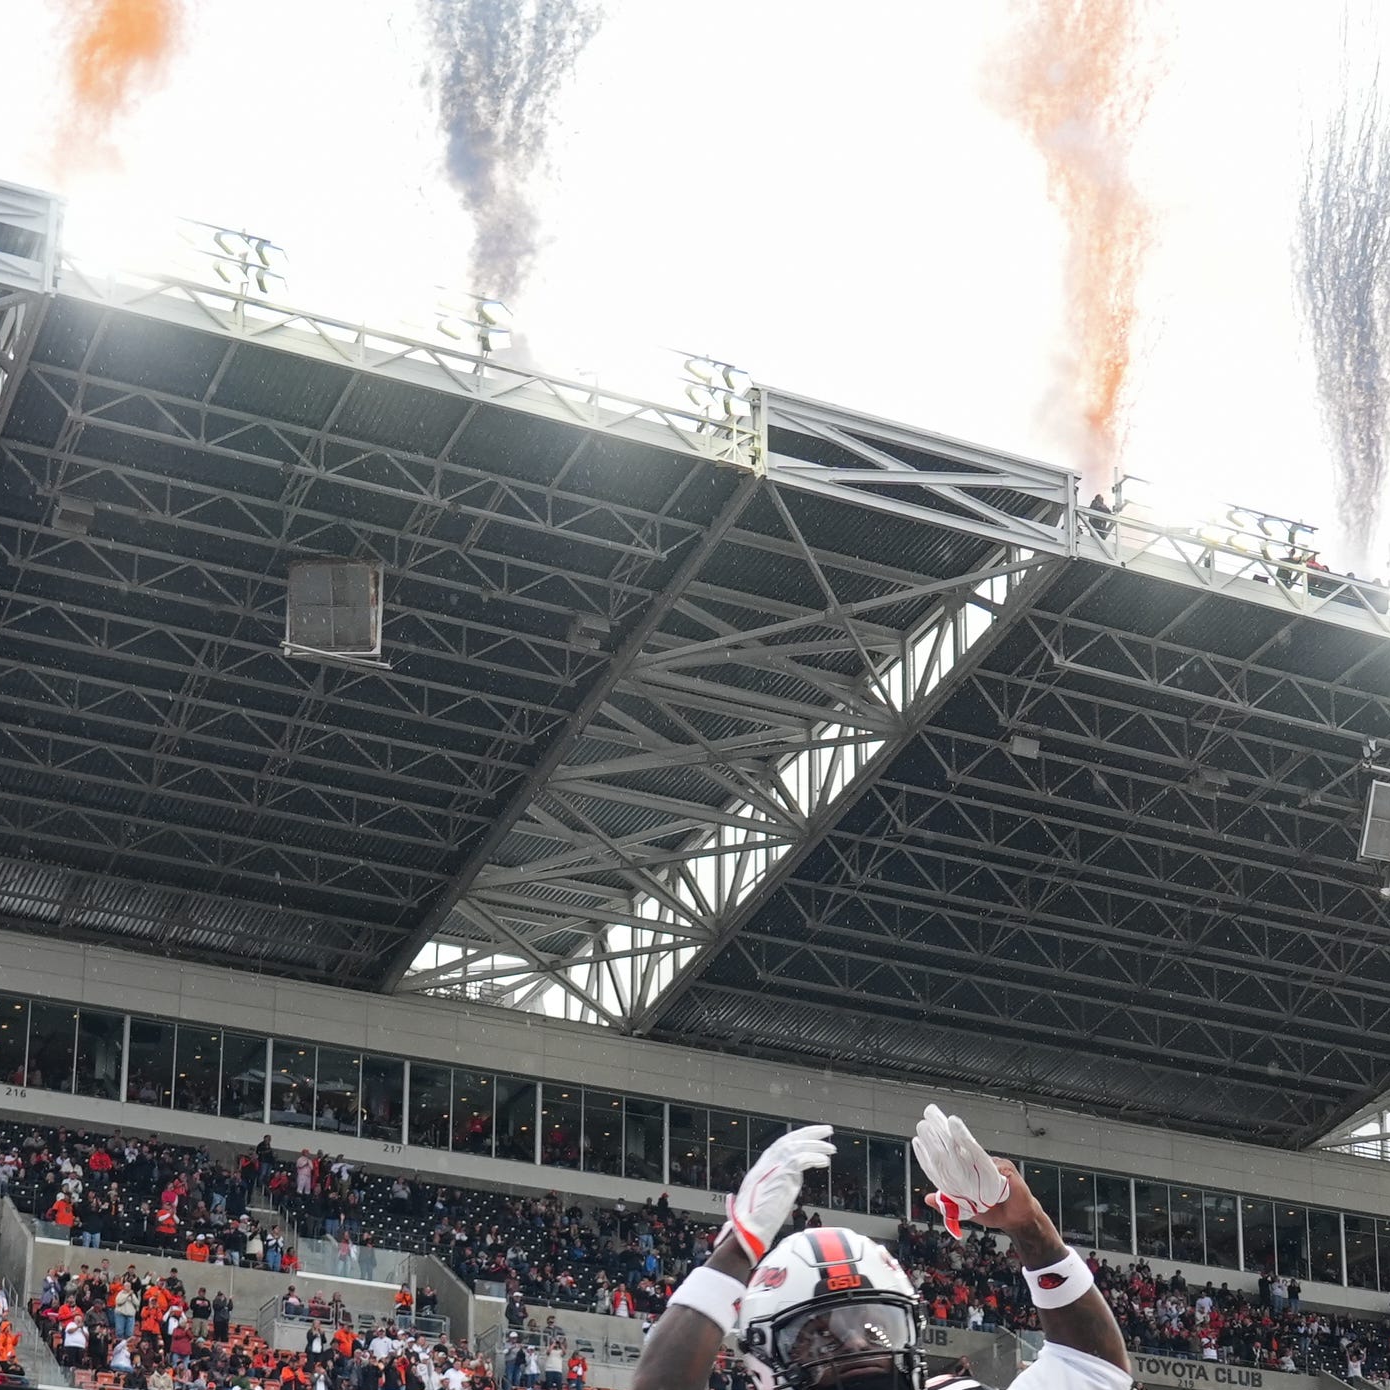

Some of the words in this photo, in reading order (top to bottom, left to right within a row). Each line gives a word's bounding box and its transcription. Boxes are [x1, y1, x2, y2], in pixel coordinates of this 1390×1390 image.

[5, 1087, 27, 1098] 216
[383, 1144, 402, 1154] 217
[827, 1275, 862, 1291] OSU
[922, 1328, 948, 1346] UB
[1135, 1356, 1209, 1381] TOYOTA
[1215, 1367, 1263, 1388] CLUB
[1178, 1379, 1195, 1389] 219
